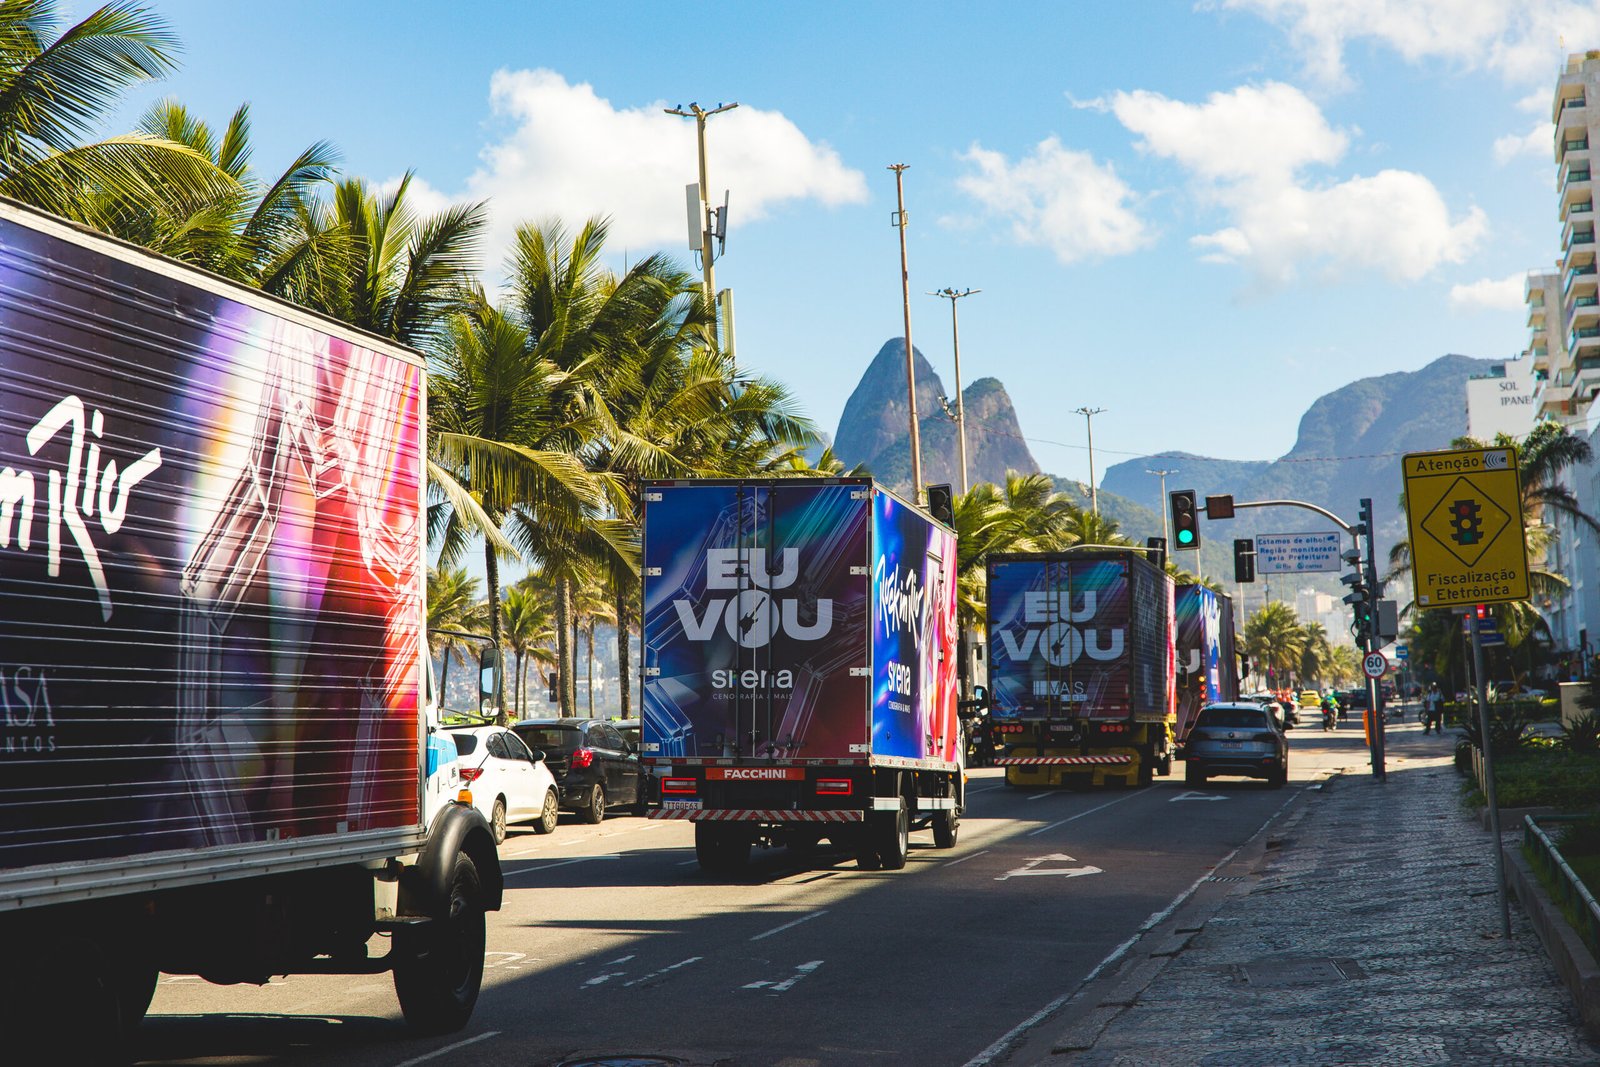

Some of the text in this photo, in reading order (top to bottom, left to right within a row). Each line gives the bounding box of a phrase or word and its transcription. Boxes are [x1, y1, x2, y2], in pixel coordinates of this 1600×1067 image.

[1499, 381, 1518, 391] SOL
[1416, 456, 1479, 472] Atenção
[1258, 538, 1291, 546] Estamos
[1260, 545, 1337, 555] Região monitorada
[1288, 553, 1330, 561] Prefeitura
[707, 547, 799, 590] EU
[1427, 568, 1516, 586] Fiscalização
[1024, 590, 1097, 623] EU
[673, 589, 833, 649] VOU
[999, 622, 1124, 667] VOU
[1366, 656, 1383, 668] 60
[723, 769, 787, 779] FACCHINI
